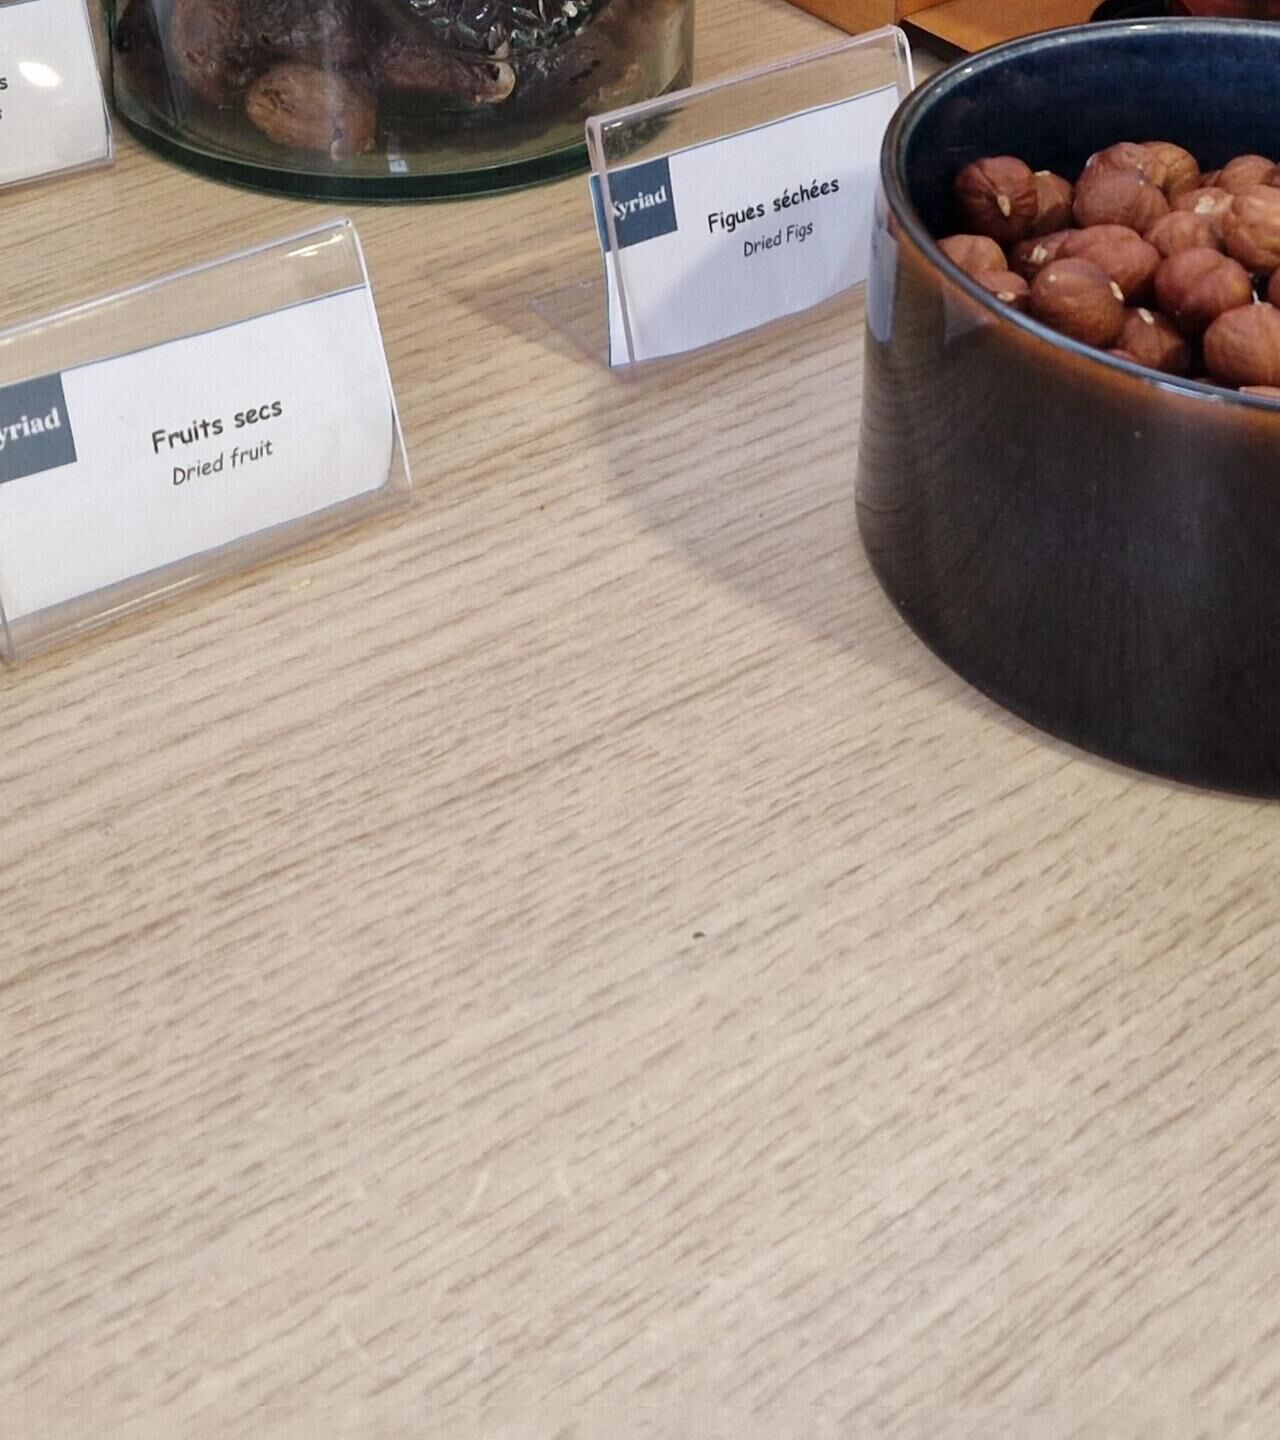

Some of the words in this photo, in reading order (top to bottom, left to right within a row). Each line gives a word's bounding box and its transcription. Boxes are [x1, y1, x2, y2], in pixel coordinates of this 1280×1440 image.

[706, 203, 766, 234] Figues
[772, 178, 840, 212] séchées
[742, 230, 783, 257] Dried
[785, 221, 814, 248] Figs
[151, 417, 224, 454] Fruits
[233, 399, 284, 429] secs
[171, 453, 224, 486] Dried
[229, 439, 274, 468] fruit
